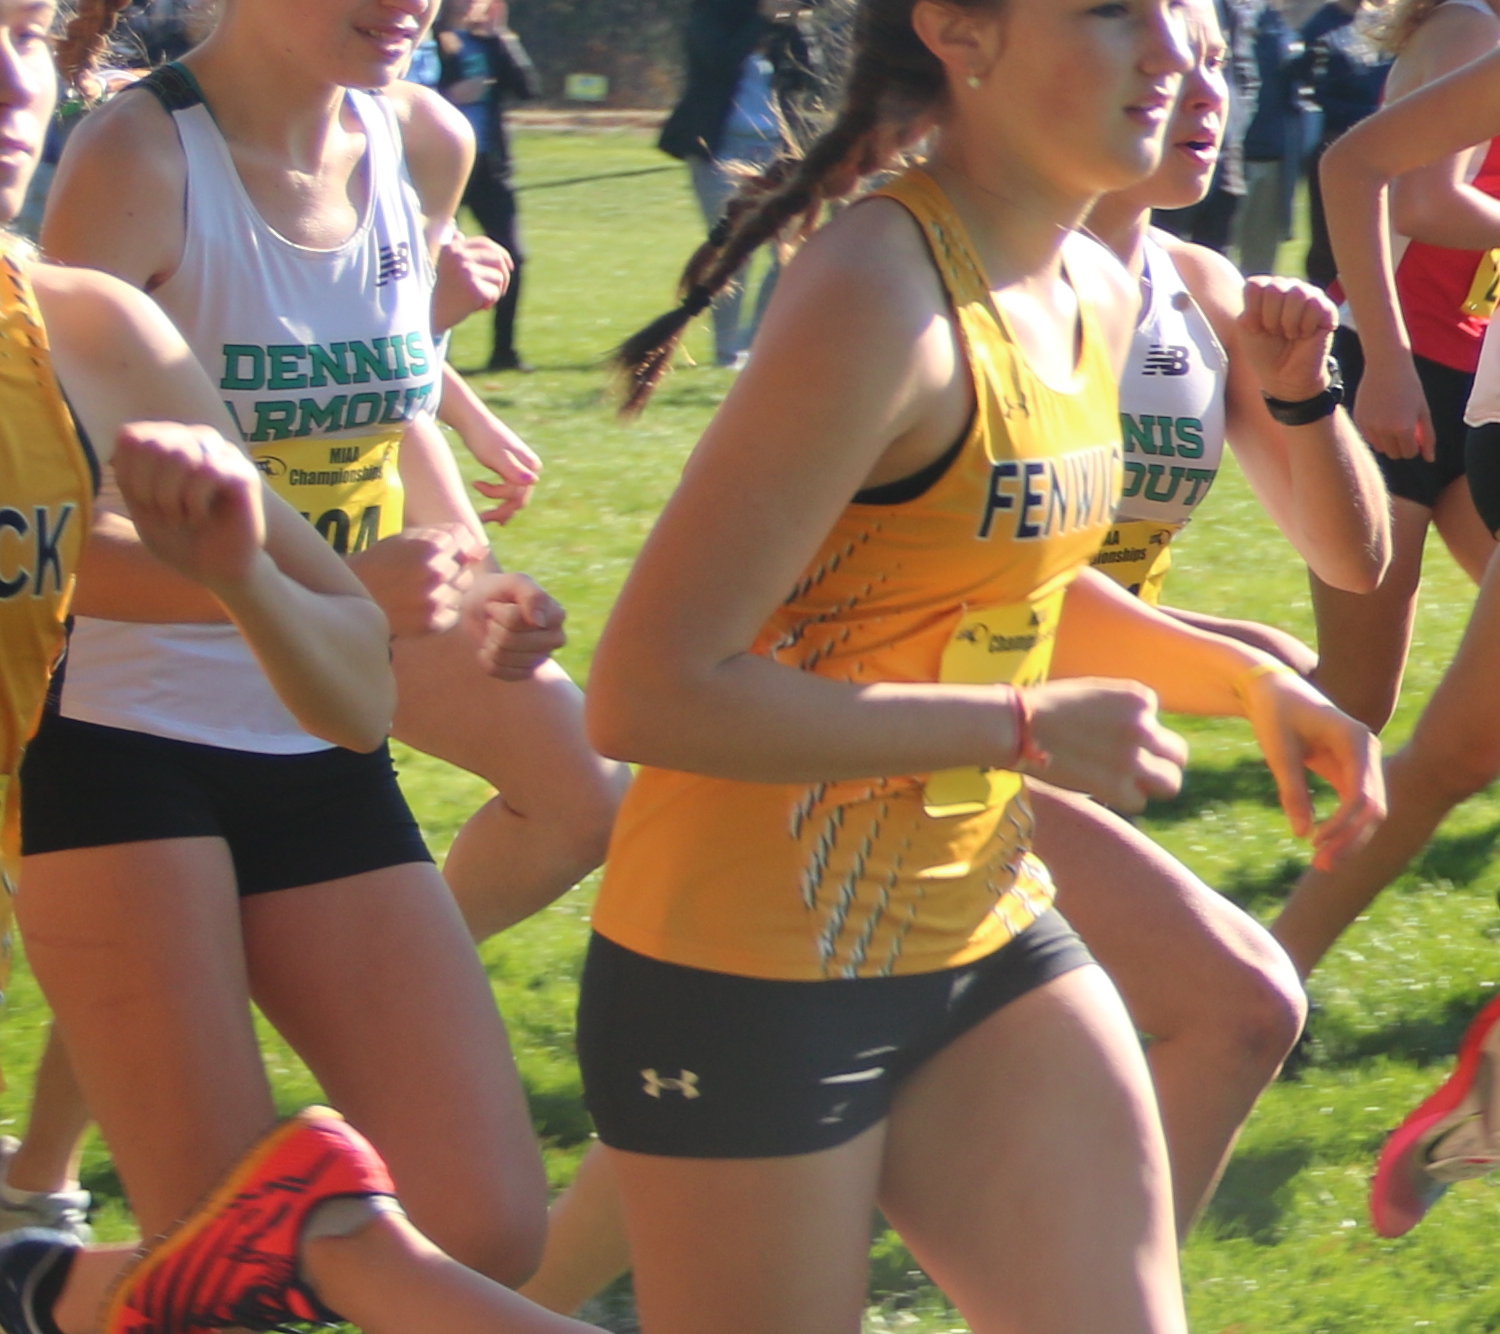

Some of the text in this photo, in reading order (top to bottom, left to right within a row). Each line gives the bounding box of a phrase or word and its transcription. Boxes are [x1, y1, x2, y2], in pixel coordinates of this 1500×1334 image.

[220, 331, 430, 391] DENNIS
[329, 446, 361, 464] MIAA
[289, 464, 384, 487] Championships
